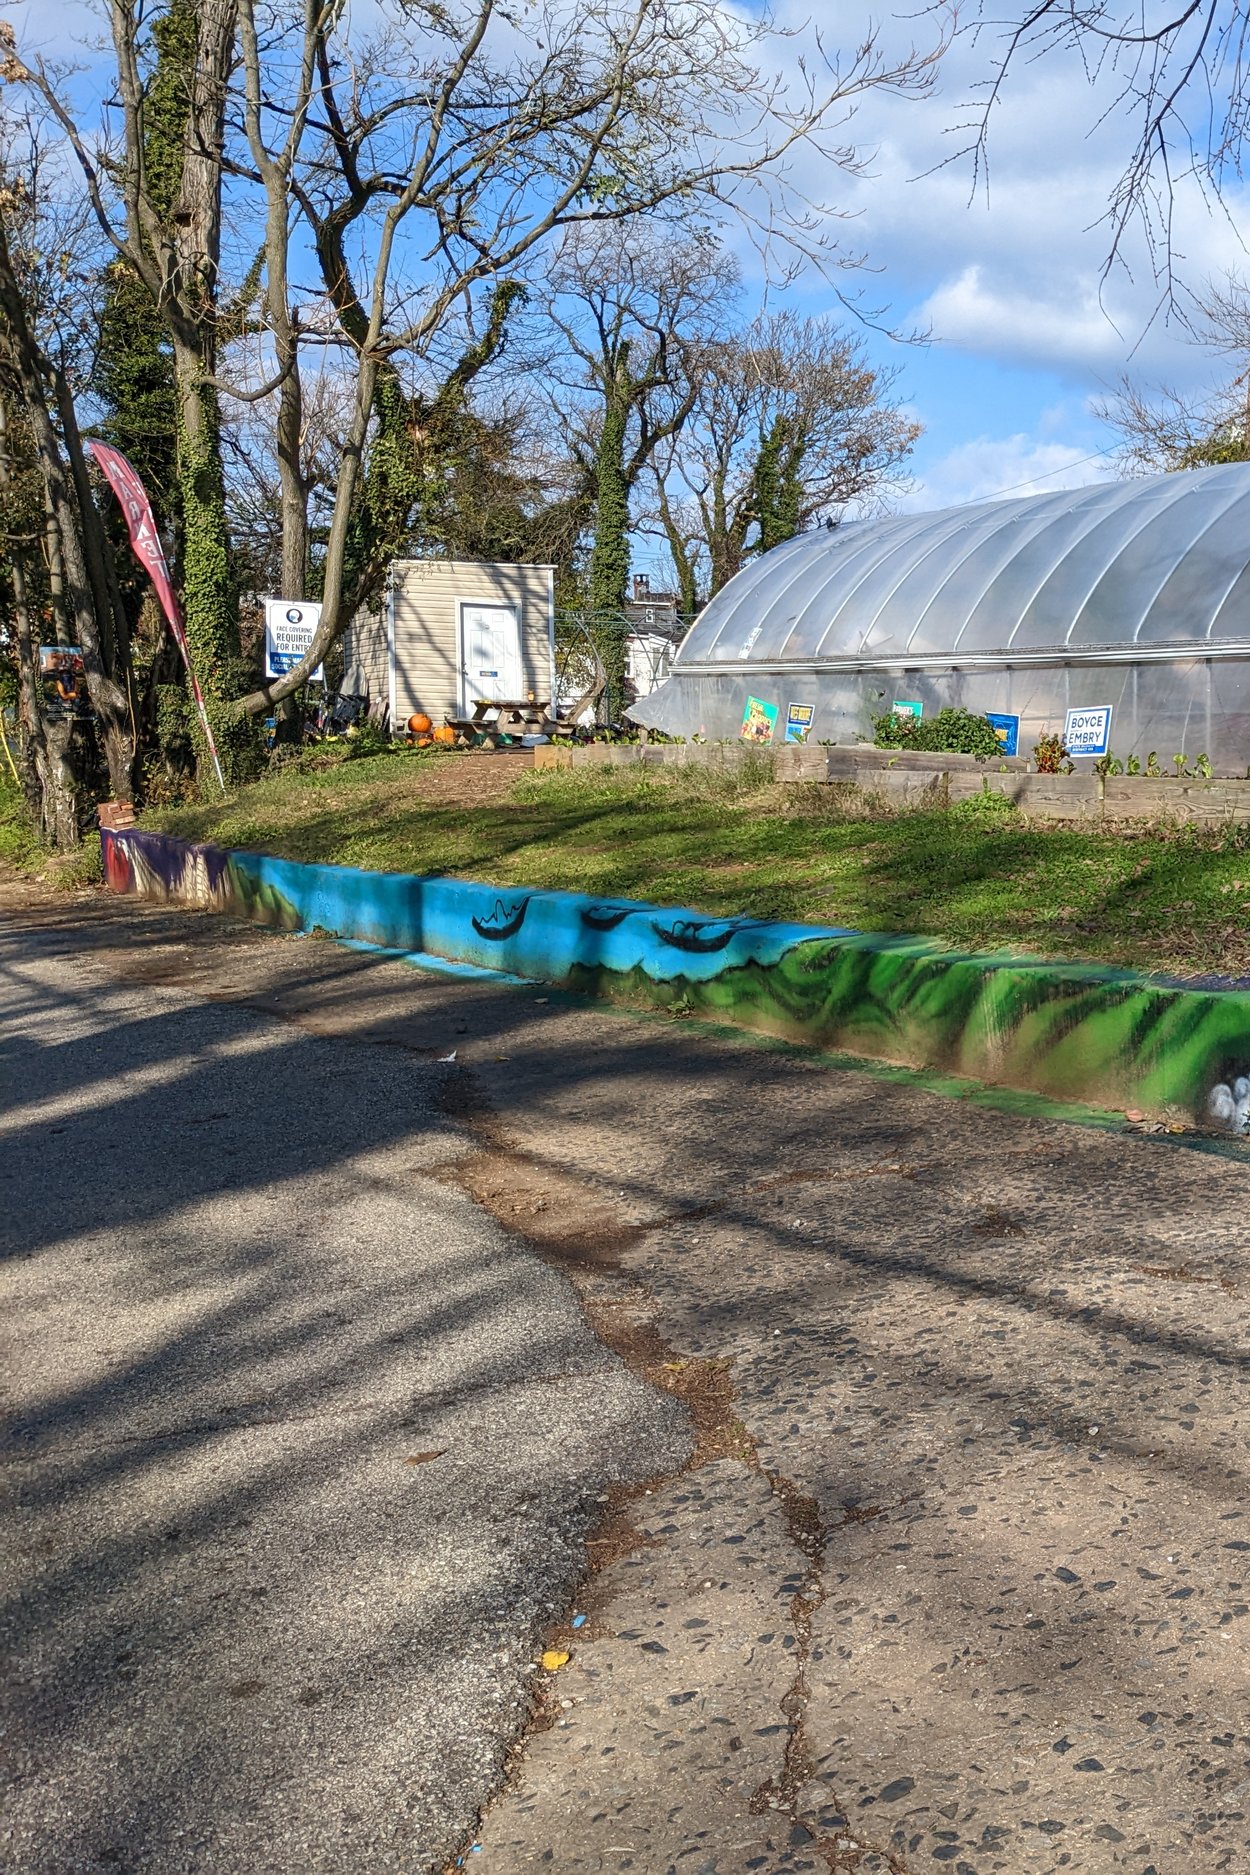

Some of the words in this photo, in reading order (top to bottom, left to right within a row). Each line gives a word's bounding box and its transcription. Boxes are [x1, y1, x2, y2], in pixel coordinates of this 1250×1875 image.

[289, 626, 313, 634] COVERING
[276, 633, 313, 643] REQUIRED
[276, 643, 290, 651] FOR
[1071, 716, 1103, 728] BOYCE
[1069, 731, 1101, 743] EMBRY
